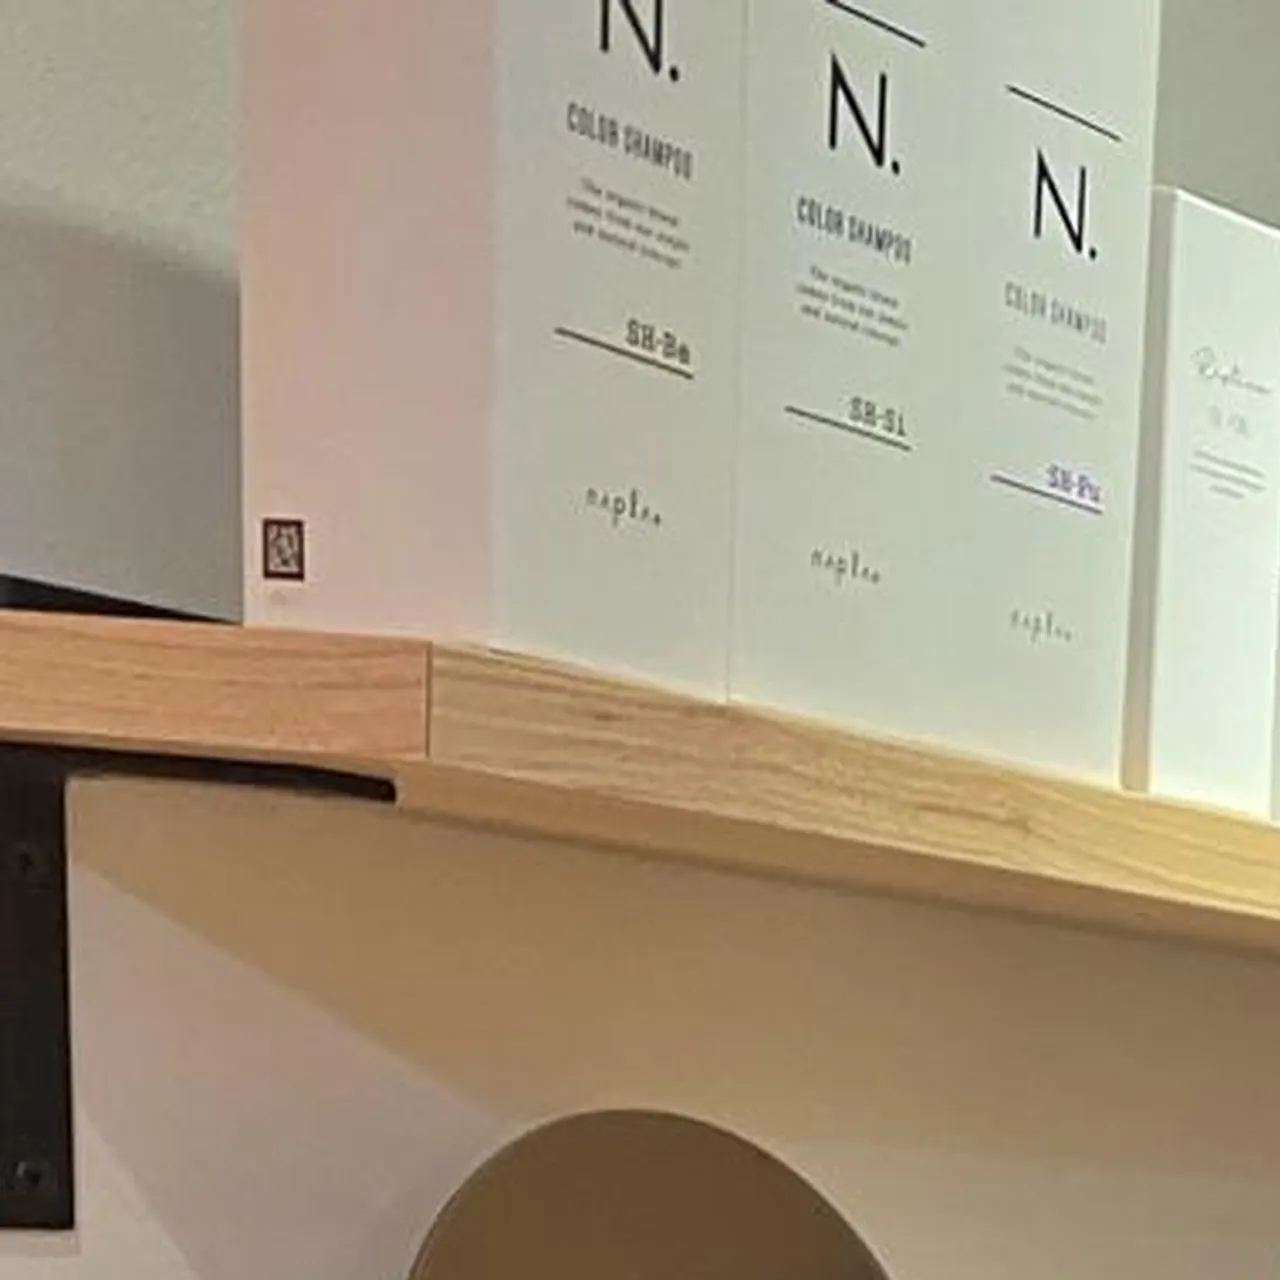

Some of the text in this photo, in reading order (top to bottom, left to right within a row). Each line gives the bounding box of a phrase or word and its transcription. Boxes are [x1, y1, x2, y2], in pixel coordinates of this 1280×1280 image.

[566, 101, 692, 181] COLOR SHAMPOO
[828, 51, 900, 176] N.
[797, 196, 912, 266] COLOR SHAMPOO
[1034, 148, 1098, 261] N.
